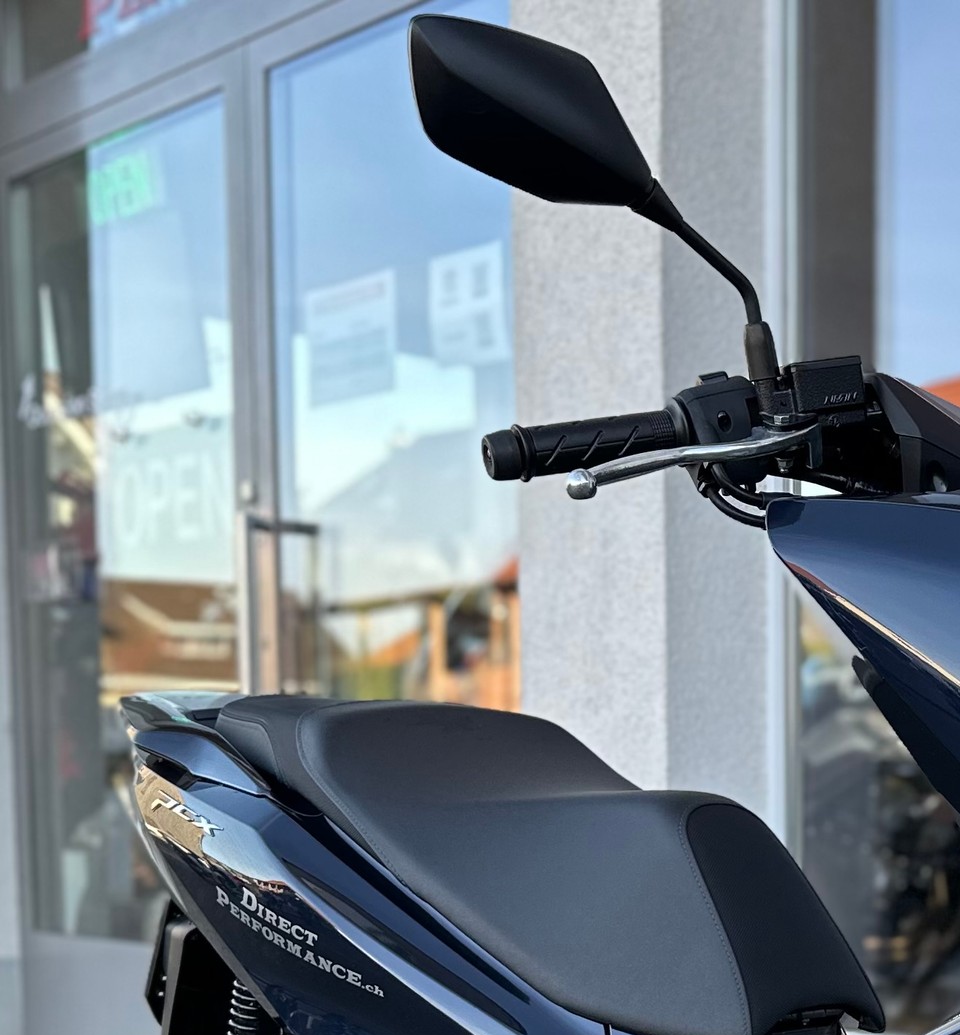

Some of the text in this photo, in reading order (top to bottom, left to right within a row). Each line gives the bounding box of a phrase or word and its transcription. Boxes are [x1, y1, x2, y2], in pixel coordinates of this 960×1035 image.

[113, 450, 232, 547] OPEN
[150, 789, 224, 837] PCX
[240, 886, 318, 947] DIRECT
